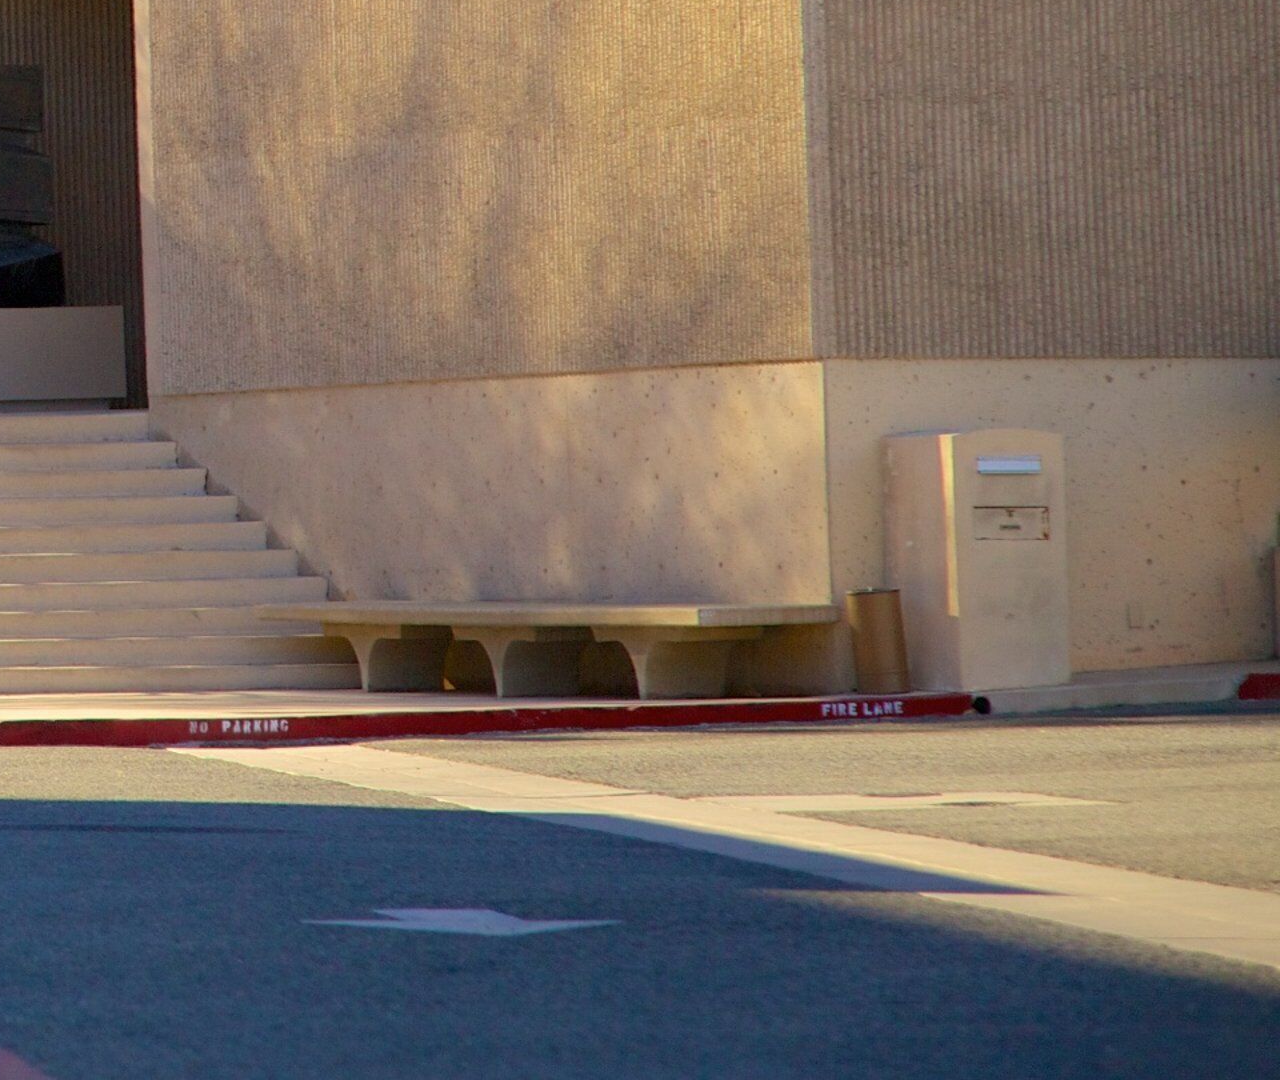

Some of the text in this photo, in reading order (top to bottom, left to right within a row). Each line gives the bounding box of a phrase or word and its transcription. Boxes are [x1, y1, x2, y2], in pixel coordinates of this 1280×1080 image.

[821, 701, 904, 717] FIRE LANE
[189, 719, 289, 734] NO PARKING
